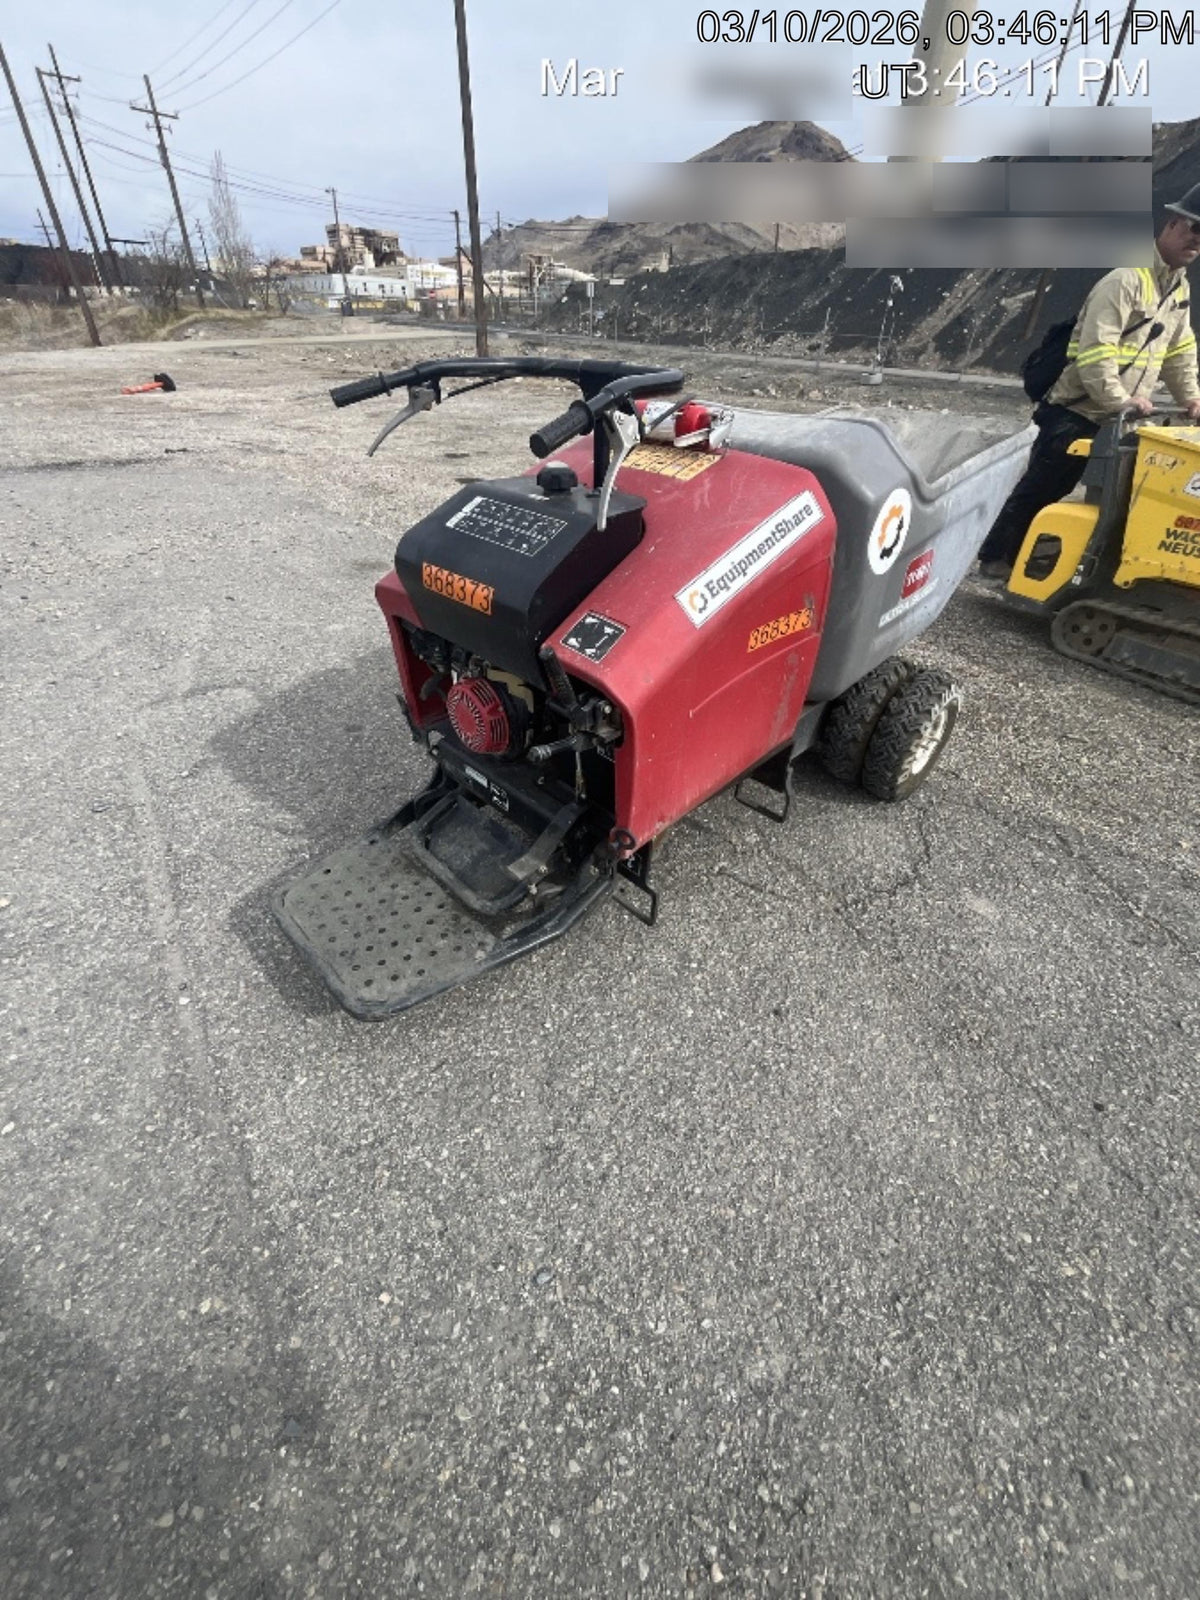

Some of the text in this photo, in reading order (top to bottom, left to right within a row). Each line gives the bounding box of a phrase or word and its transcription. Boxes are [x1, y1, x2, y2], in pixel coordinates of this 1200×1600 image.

[704, 503, 814, 599] EquipmentShare
[424, 564, 490, 612] 368373
[750, 609, 810, 650] 368373
